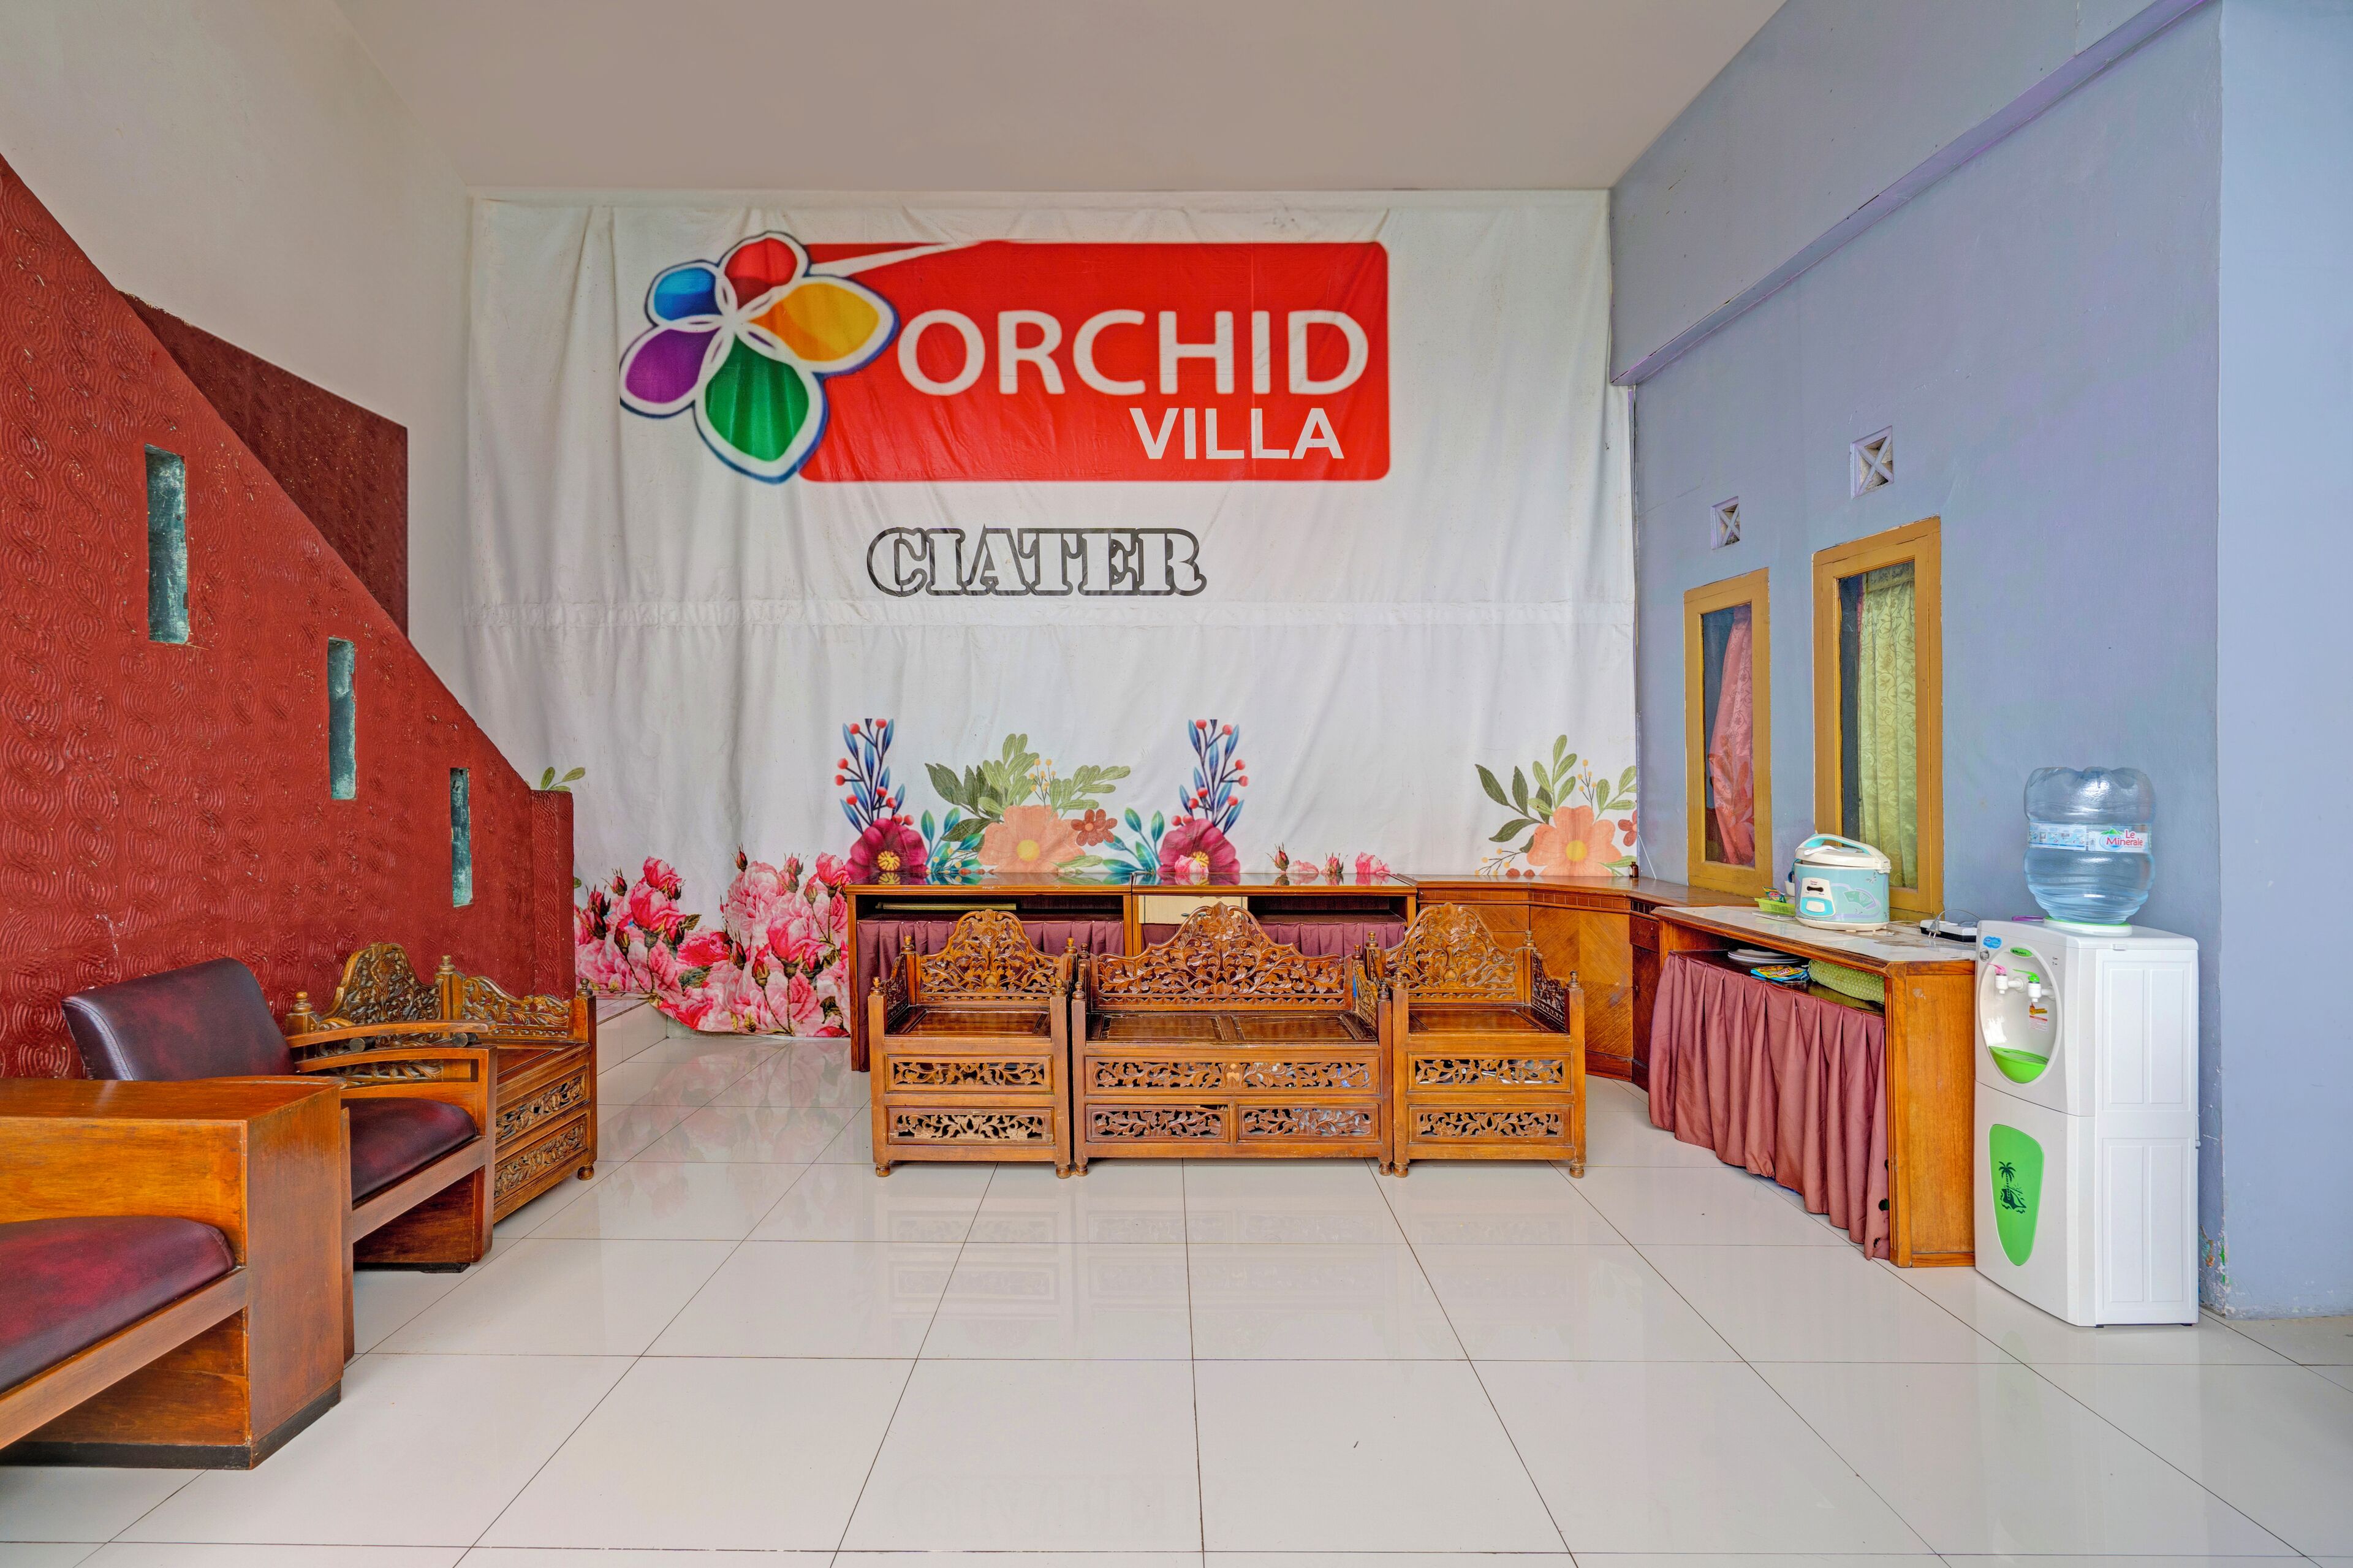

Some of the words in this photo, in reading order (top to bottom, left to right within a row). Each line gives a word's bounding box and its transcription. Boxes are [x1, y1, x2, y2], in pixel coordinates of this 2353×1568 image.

[898, 309, 1369, 395] ORCHID
[1129, 408, 1344, 459] VILLA
[866, 525, 1207, 597] CIATER
[2106, 837, 2143, 846] Minerale
[2125, 830, 2135, 838] Le
